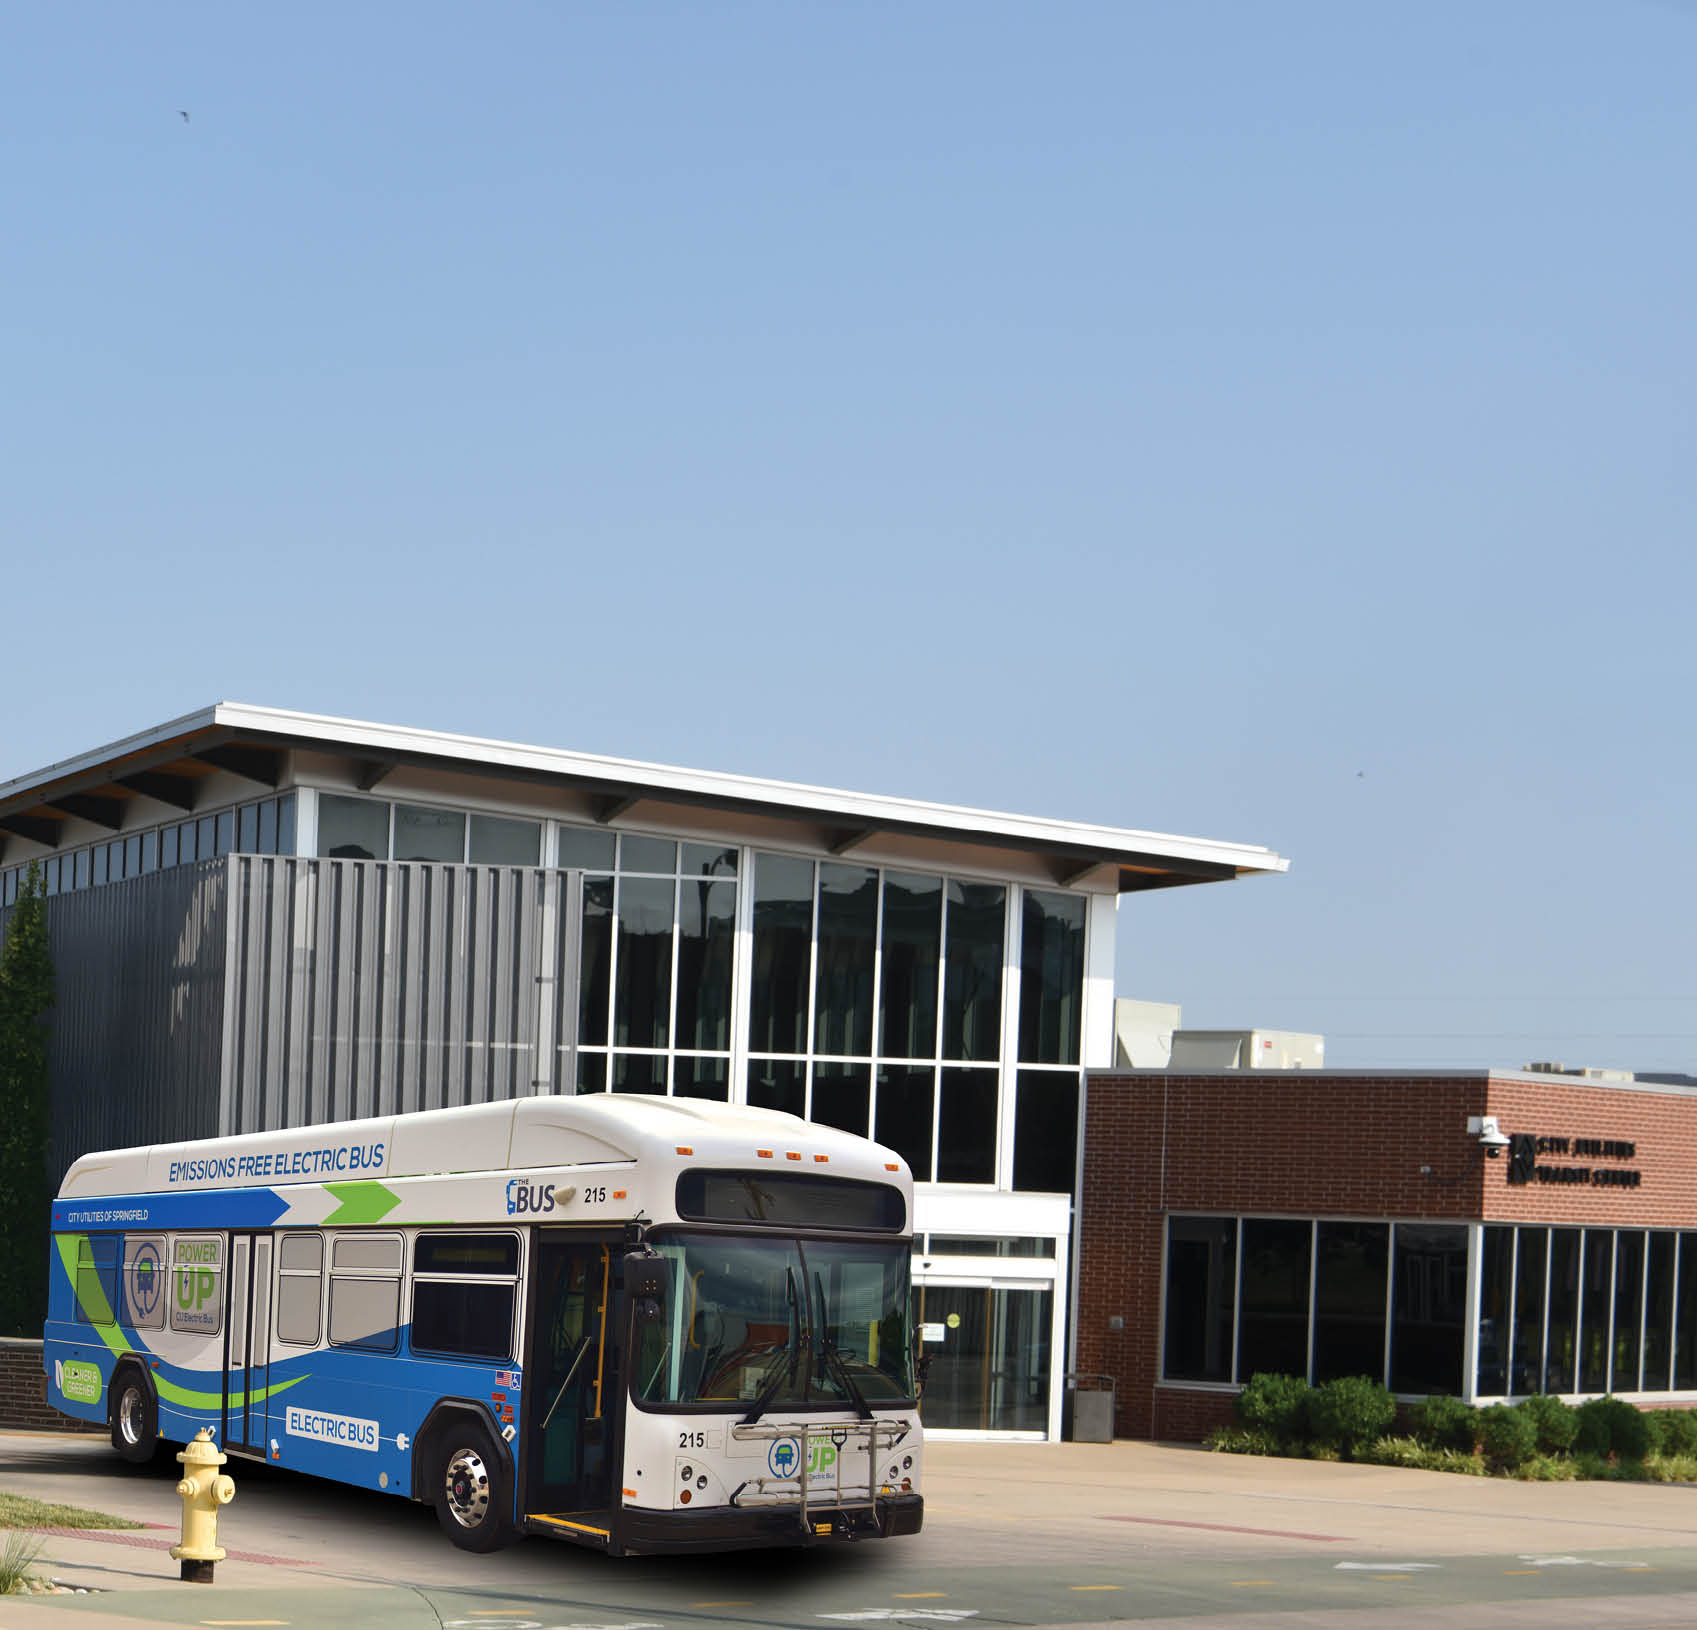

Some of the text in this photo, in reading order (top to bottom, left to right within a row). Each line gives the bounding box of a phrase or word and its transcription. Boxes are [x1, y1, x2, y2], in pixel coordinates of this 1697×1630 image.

[169, 1143, 385, 1182] EMISSIONS FREE ELECTRIC BUS
[516, 1184, 555, 1213] BUS
[584, 1187, 606, 1203] 215
[68, 1209, 149, 1223] CITY UTILITIES OF SPRINGFIELD
[178, 1243, 217, 1262] POWER
[177, 1266, 215, 1310] UP
[290, 1412, 374, 1445] ELECTRIC BUS
[679, 1432, 704, 1448] 215
